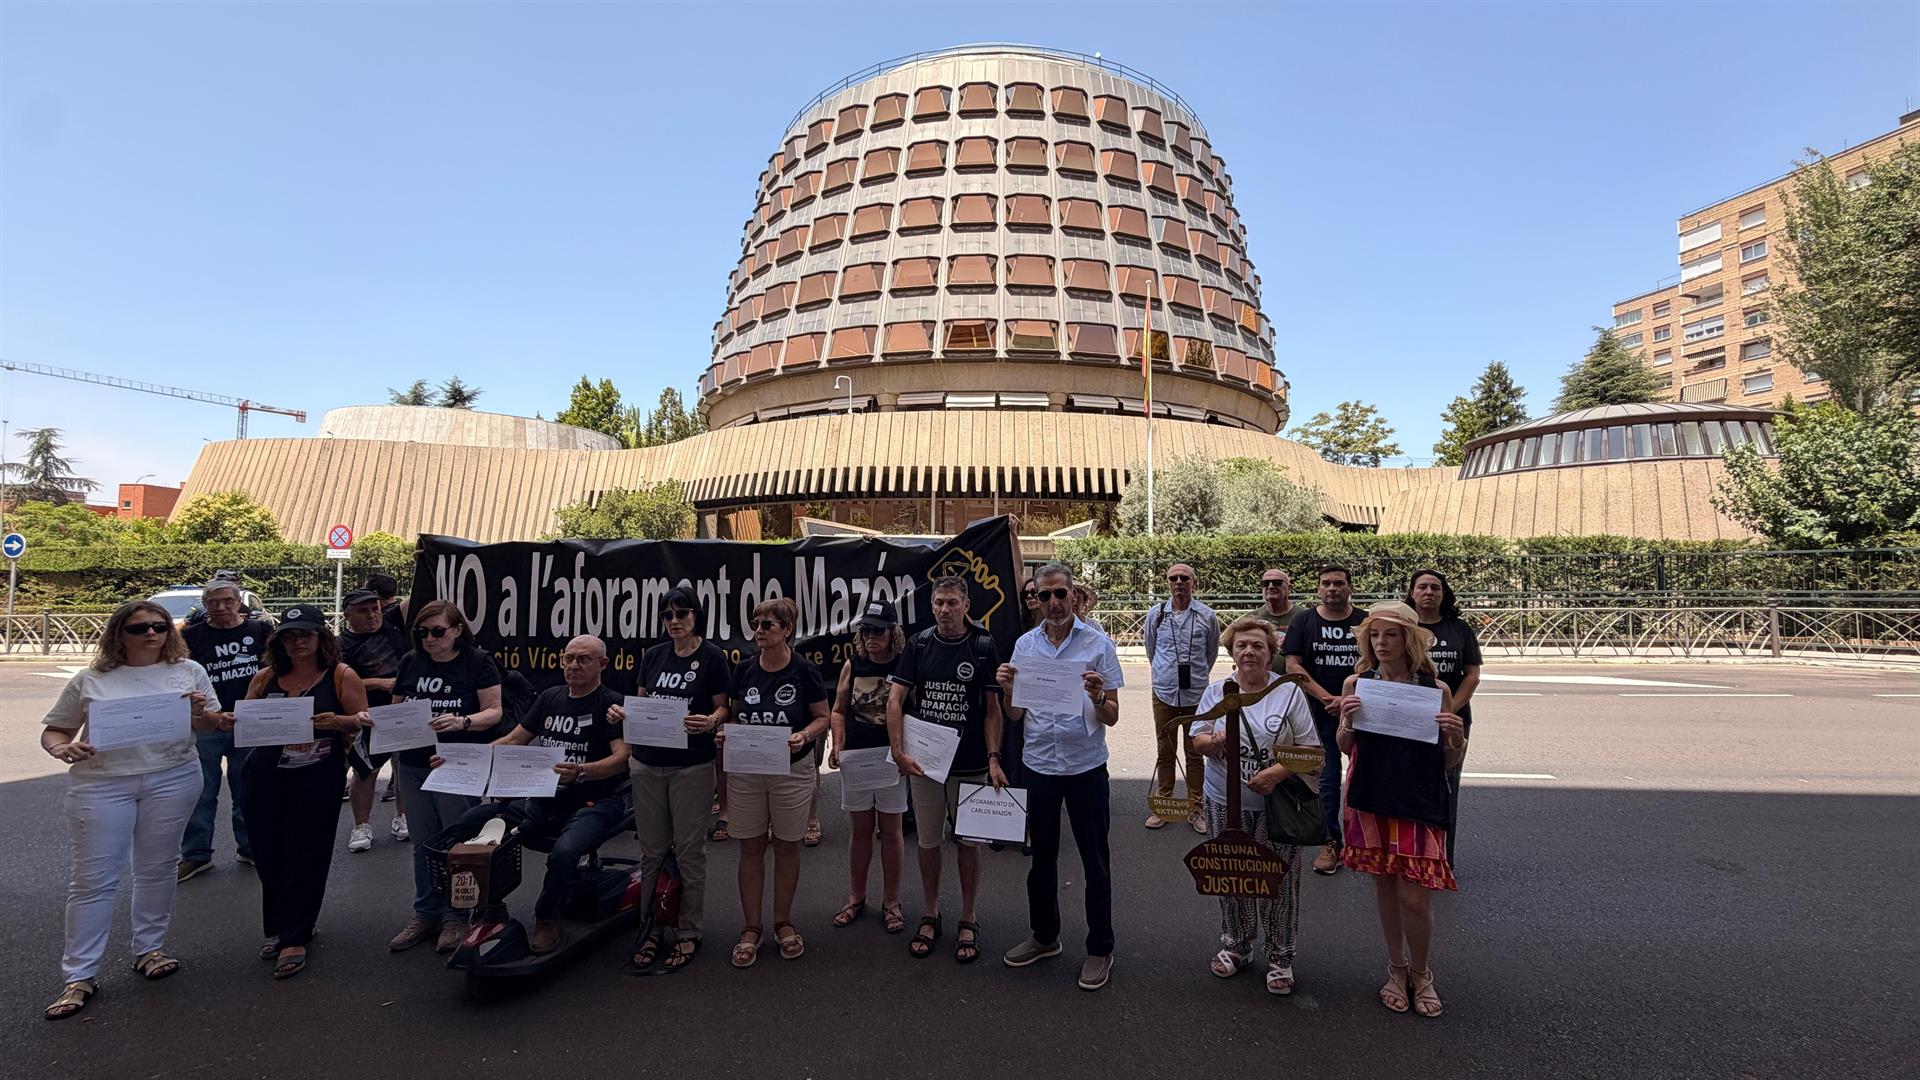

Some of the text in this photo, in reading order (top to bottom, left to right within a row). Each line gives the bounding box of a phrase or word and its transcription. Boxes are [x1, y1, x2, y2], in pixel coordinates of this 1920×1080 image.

[436, 553, 486, 637] NO
[498, 575, 517, 637] a
[1321, 626, 1344, 640] NO
[214, 641, 241, 658] NO
[1312, 641, 1359, 652] l'aforamen
[614, 647, 634, 671] de
[1314, 655, 1325, 666] de
[221, 663, 259, 681] MAZÓN
[416, 676, 453, 694] NO a
[655, 671, 688, 690] NO a
[923, 680, 967, 693] JUSTÍCIA
[925, 690, 966, 702] VERITAT
[738, 710, 790, 725] SARA
[551, 715, 582, 736] NO a
[1276, 751, 1323, 762] AFORAMIENTO
[968, 797, 1008, 808] AFORAMIENTO
[1153, 799, 1190, 808] DERECHOS
[970, 807, 991, 815] CARLOS
[1203, 842, 1261, 857] TRIBUNAL
[1189, 855, 1285, 875] CONSTITUCIONAL
[1202, 874, 1271, 896] JUSTICIA
